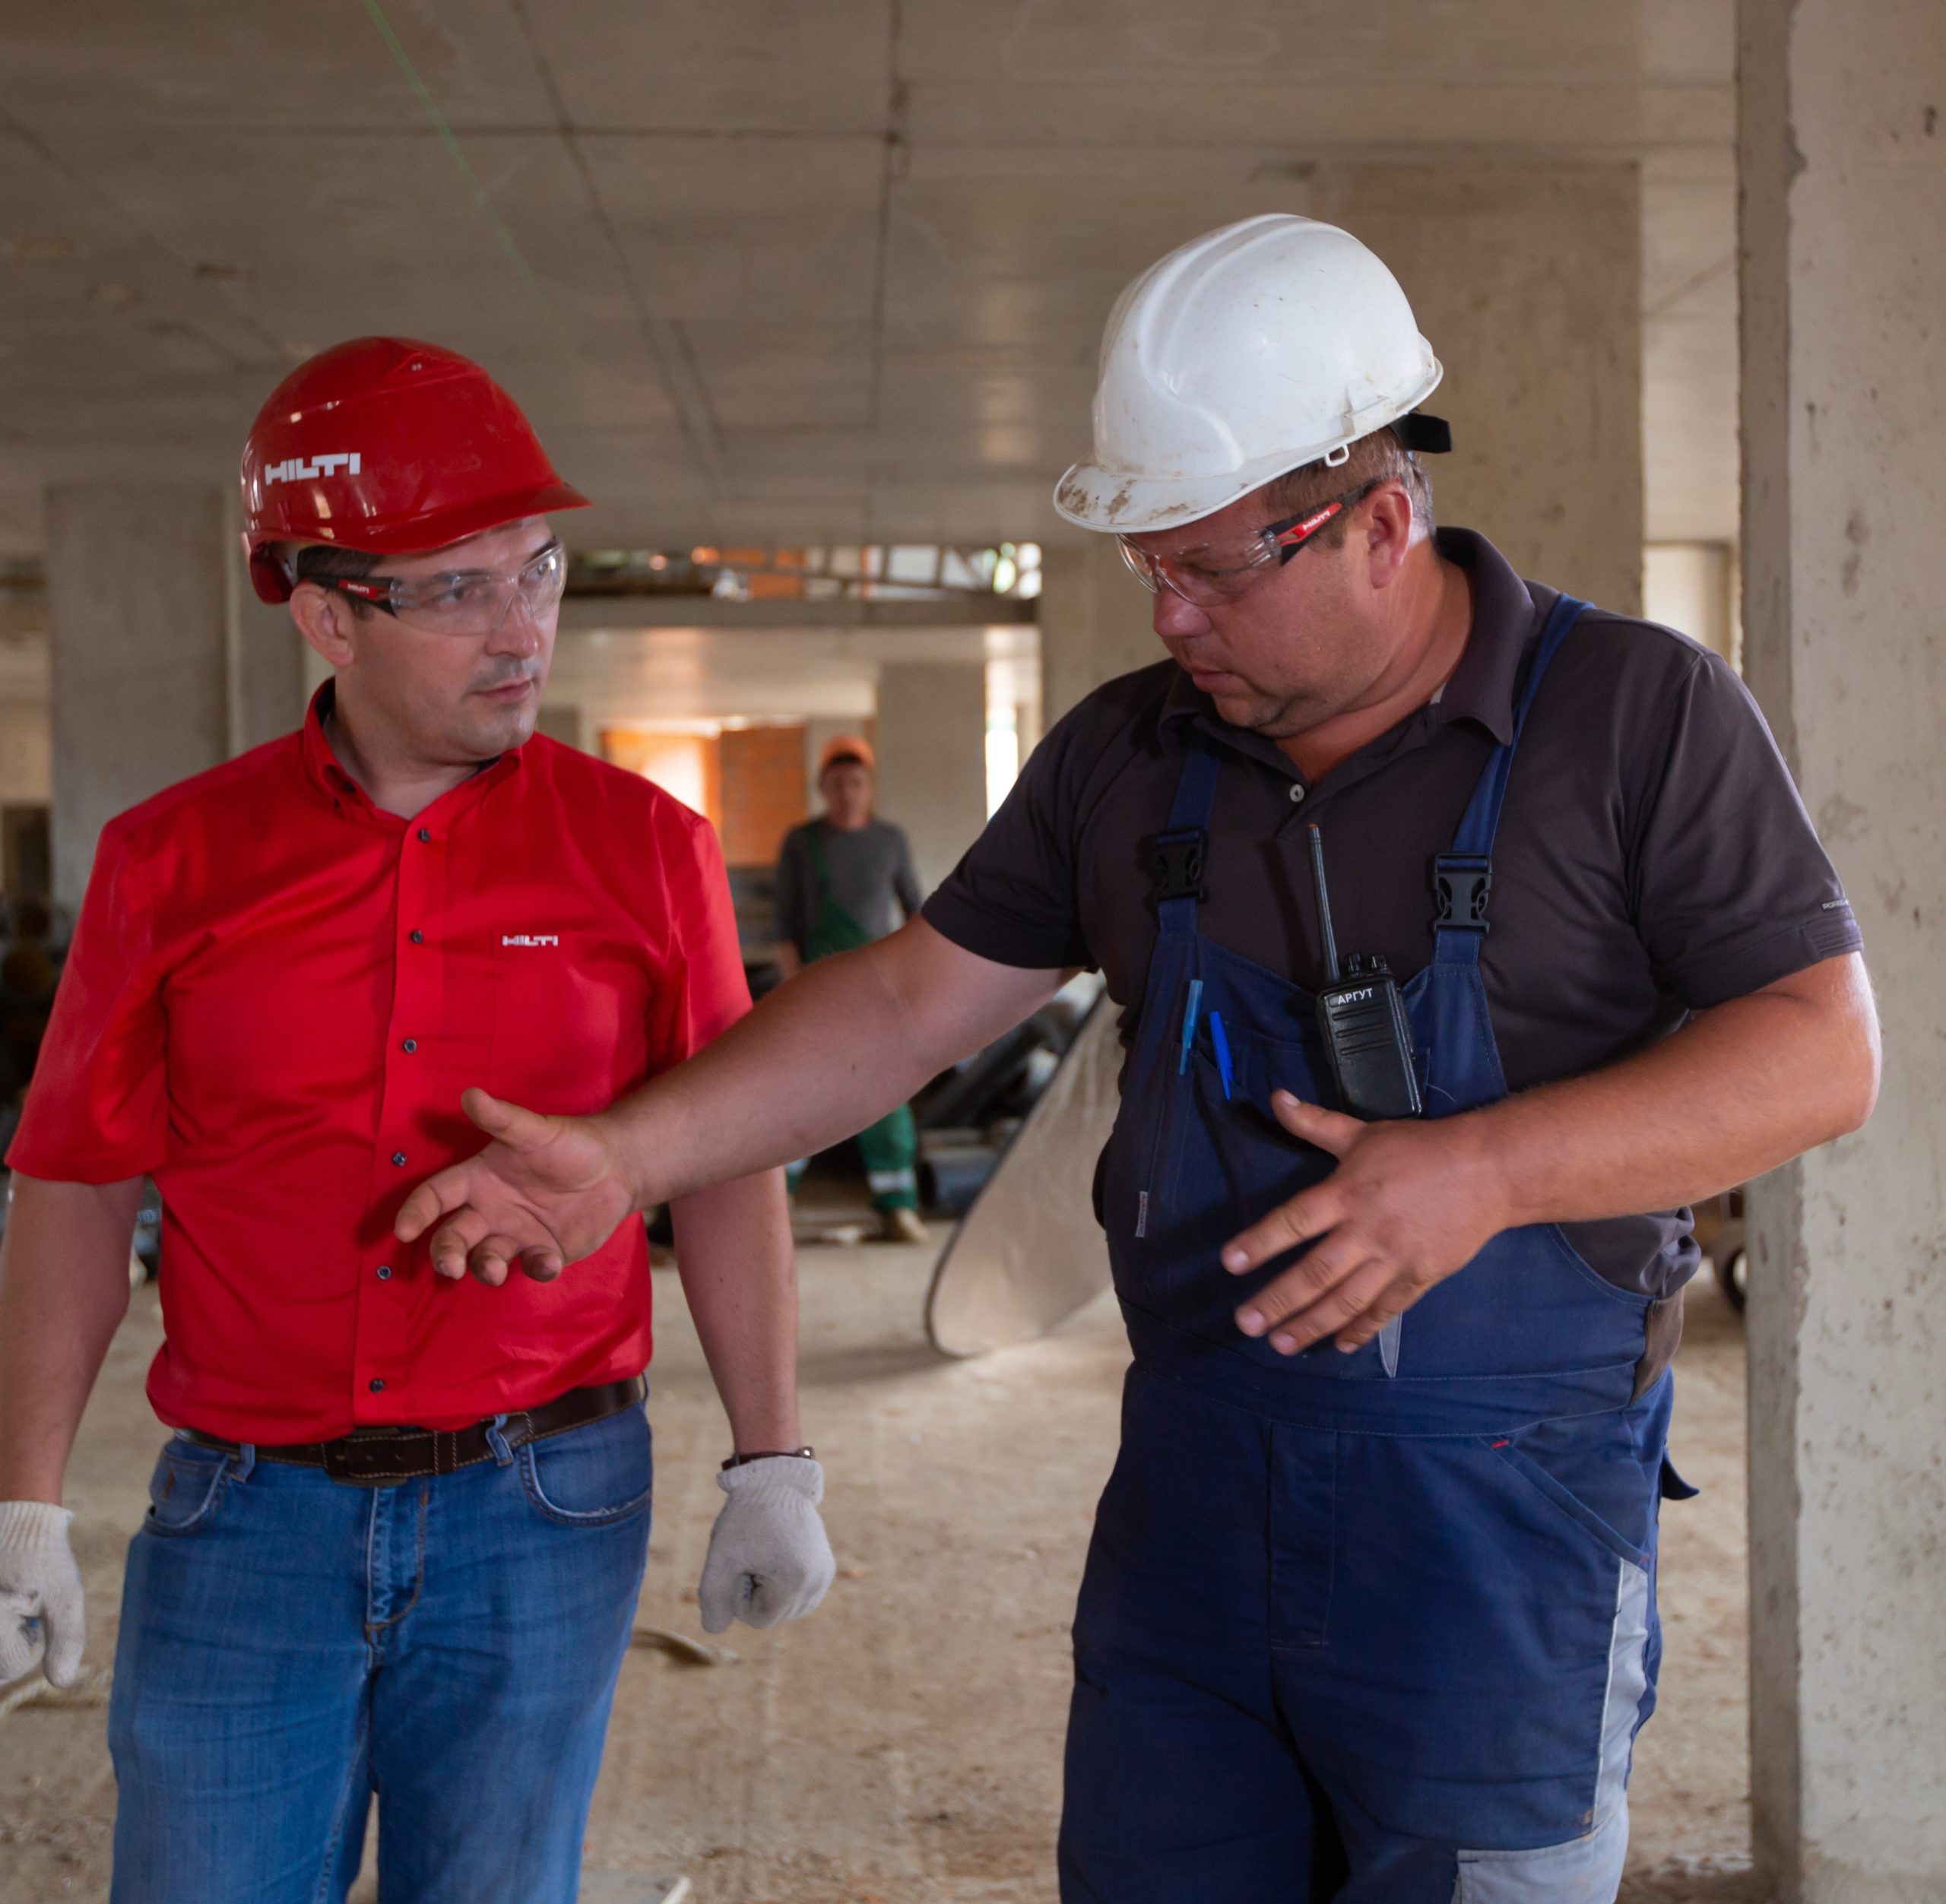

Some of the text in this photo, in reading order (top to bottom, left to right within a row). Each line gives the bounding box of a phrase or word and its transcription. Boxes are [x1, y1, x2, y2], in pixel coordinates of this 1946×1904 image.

[265, 452, 361, 486] HILTI
[502, 935, 558, 946] HILTI
[1338, 988, 1372, 1005] АРГУТ
